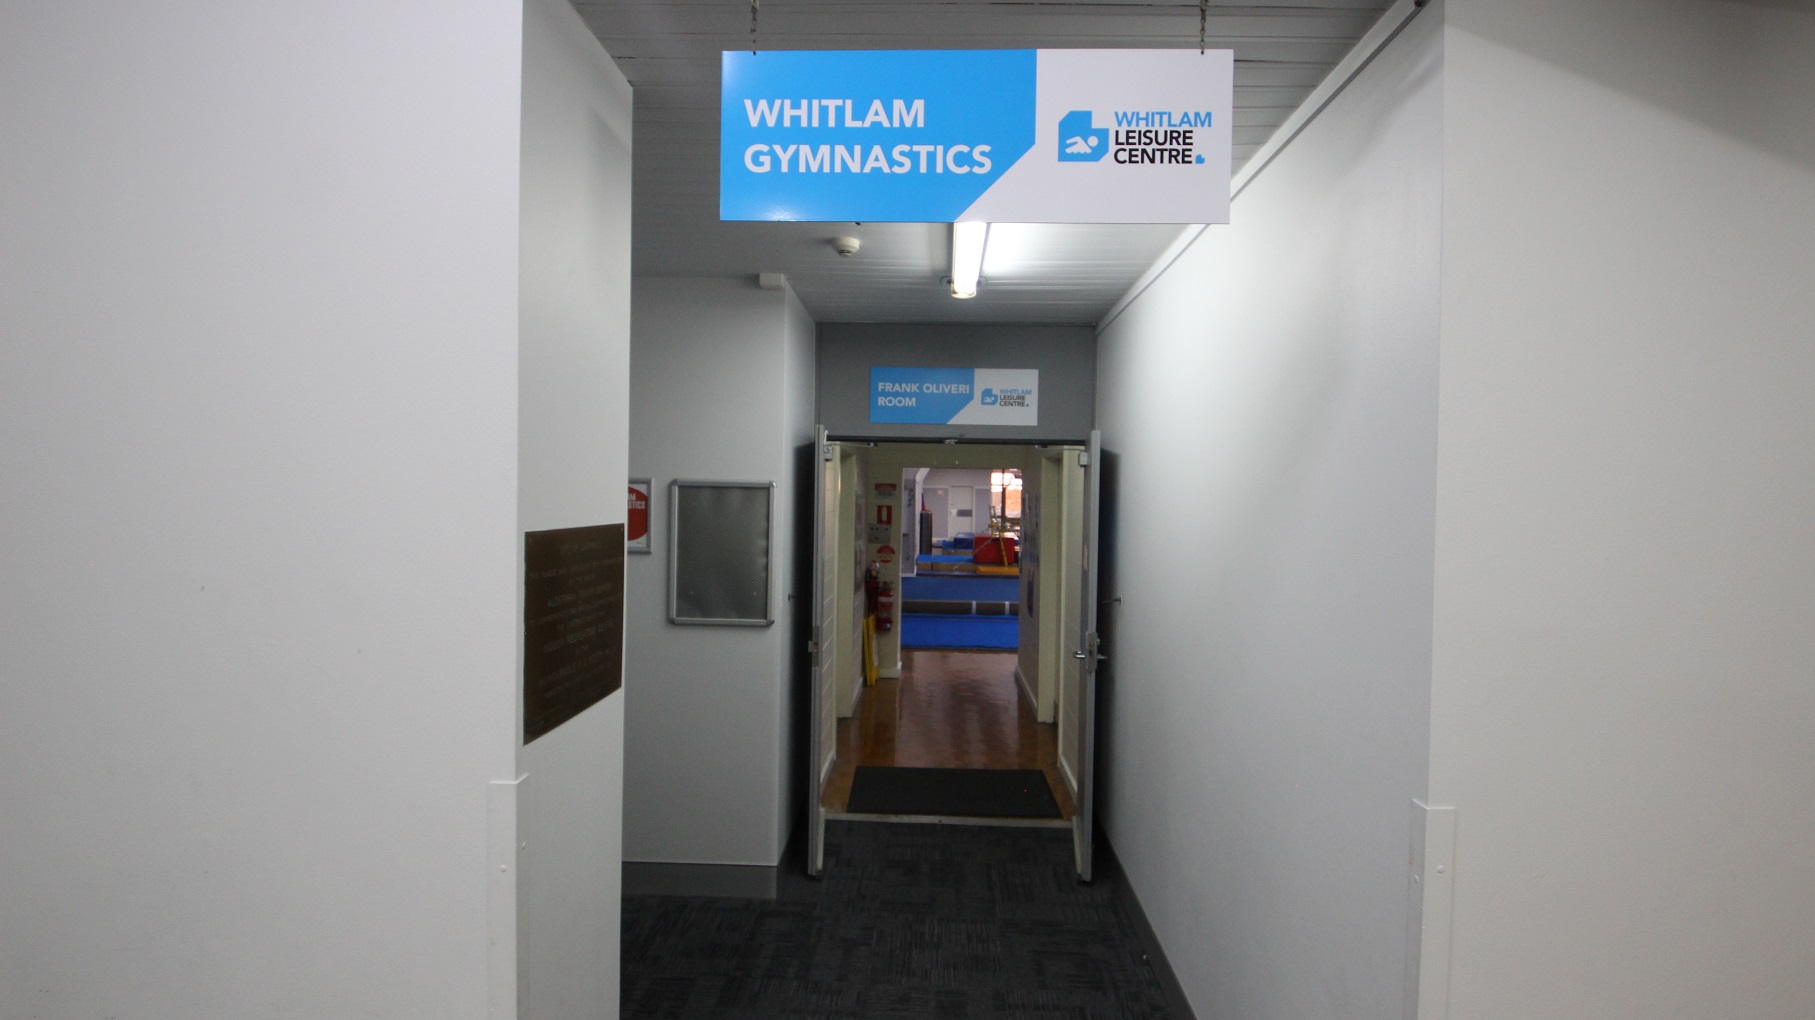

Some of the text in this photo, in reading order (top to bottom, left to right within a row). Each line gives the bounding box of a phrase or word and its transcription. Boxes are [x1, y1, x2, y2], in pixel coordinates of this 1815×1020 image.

[744, 99, 926, 128] WHITLAM
[1114, 111, 1212, 128] WHITLAM
[1114, 129, 1194, 146] LEISURE
[744, 144, 993, 175] GYMNASTICS
[1113, 148, 1193, 165] CENTRE
[878, 382, 970, 394] FRANK OLIVERI
[1000, 388, 1032, 396] WHITLAM
[878, 396, 917, 407] ROOM
